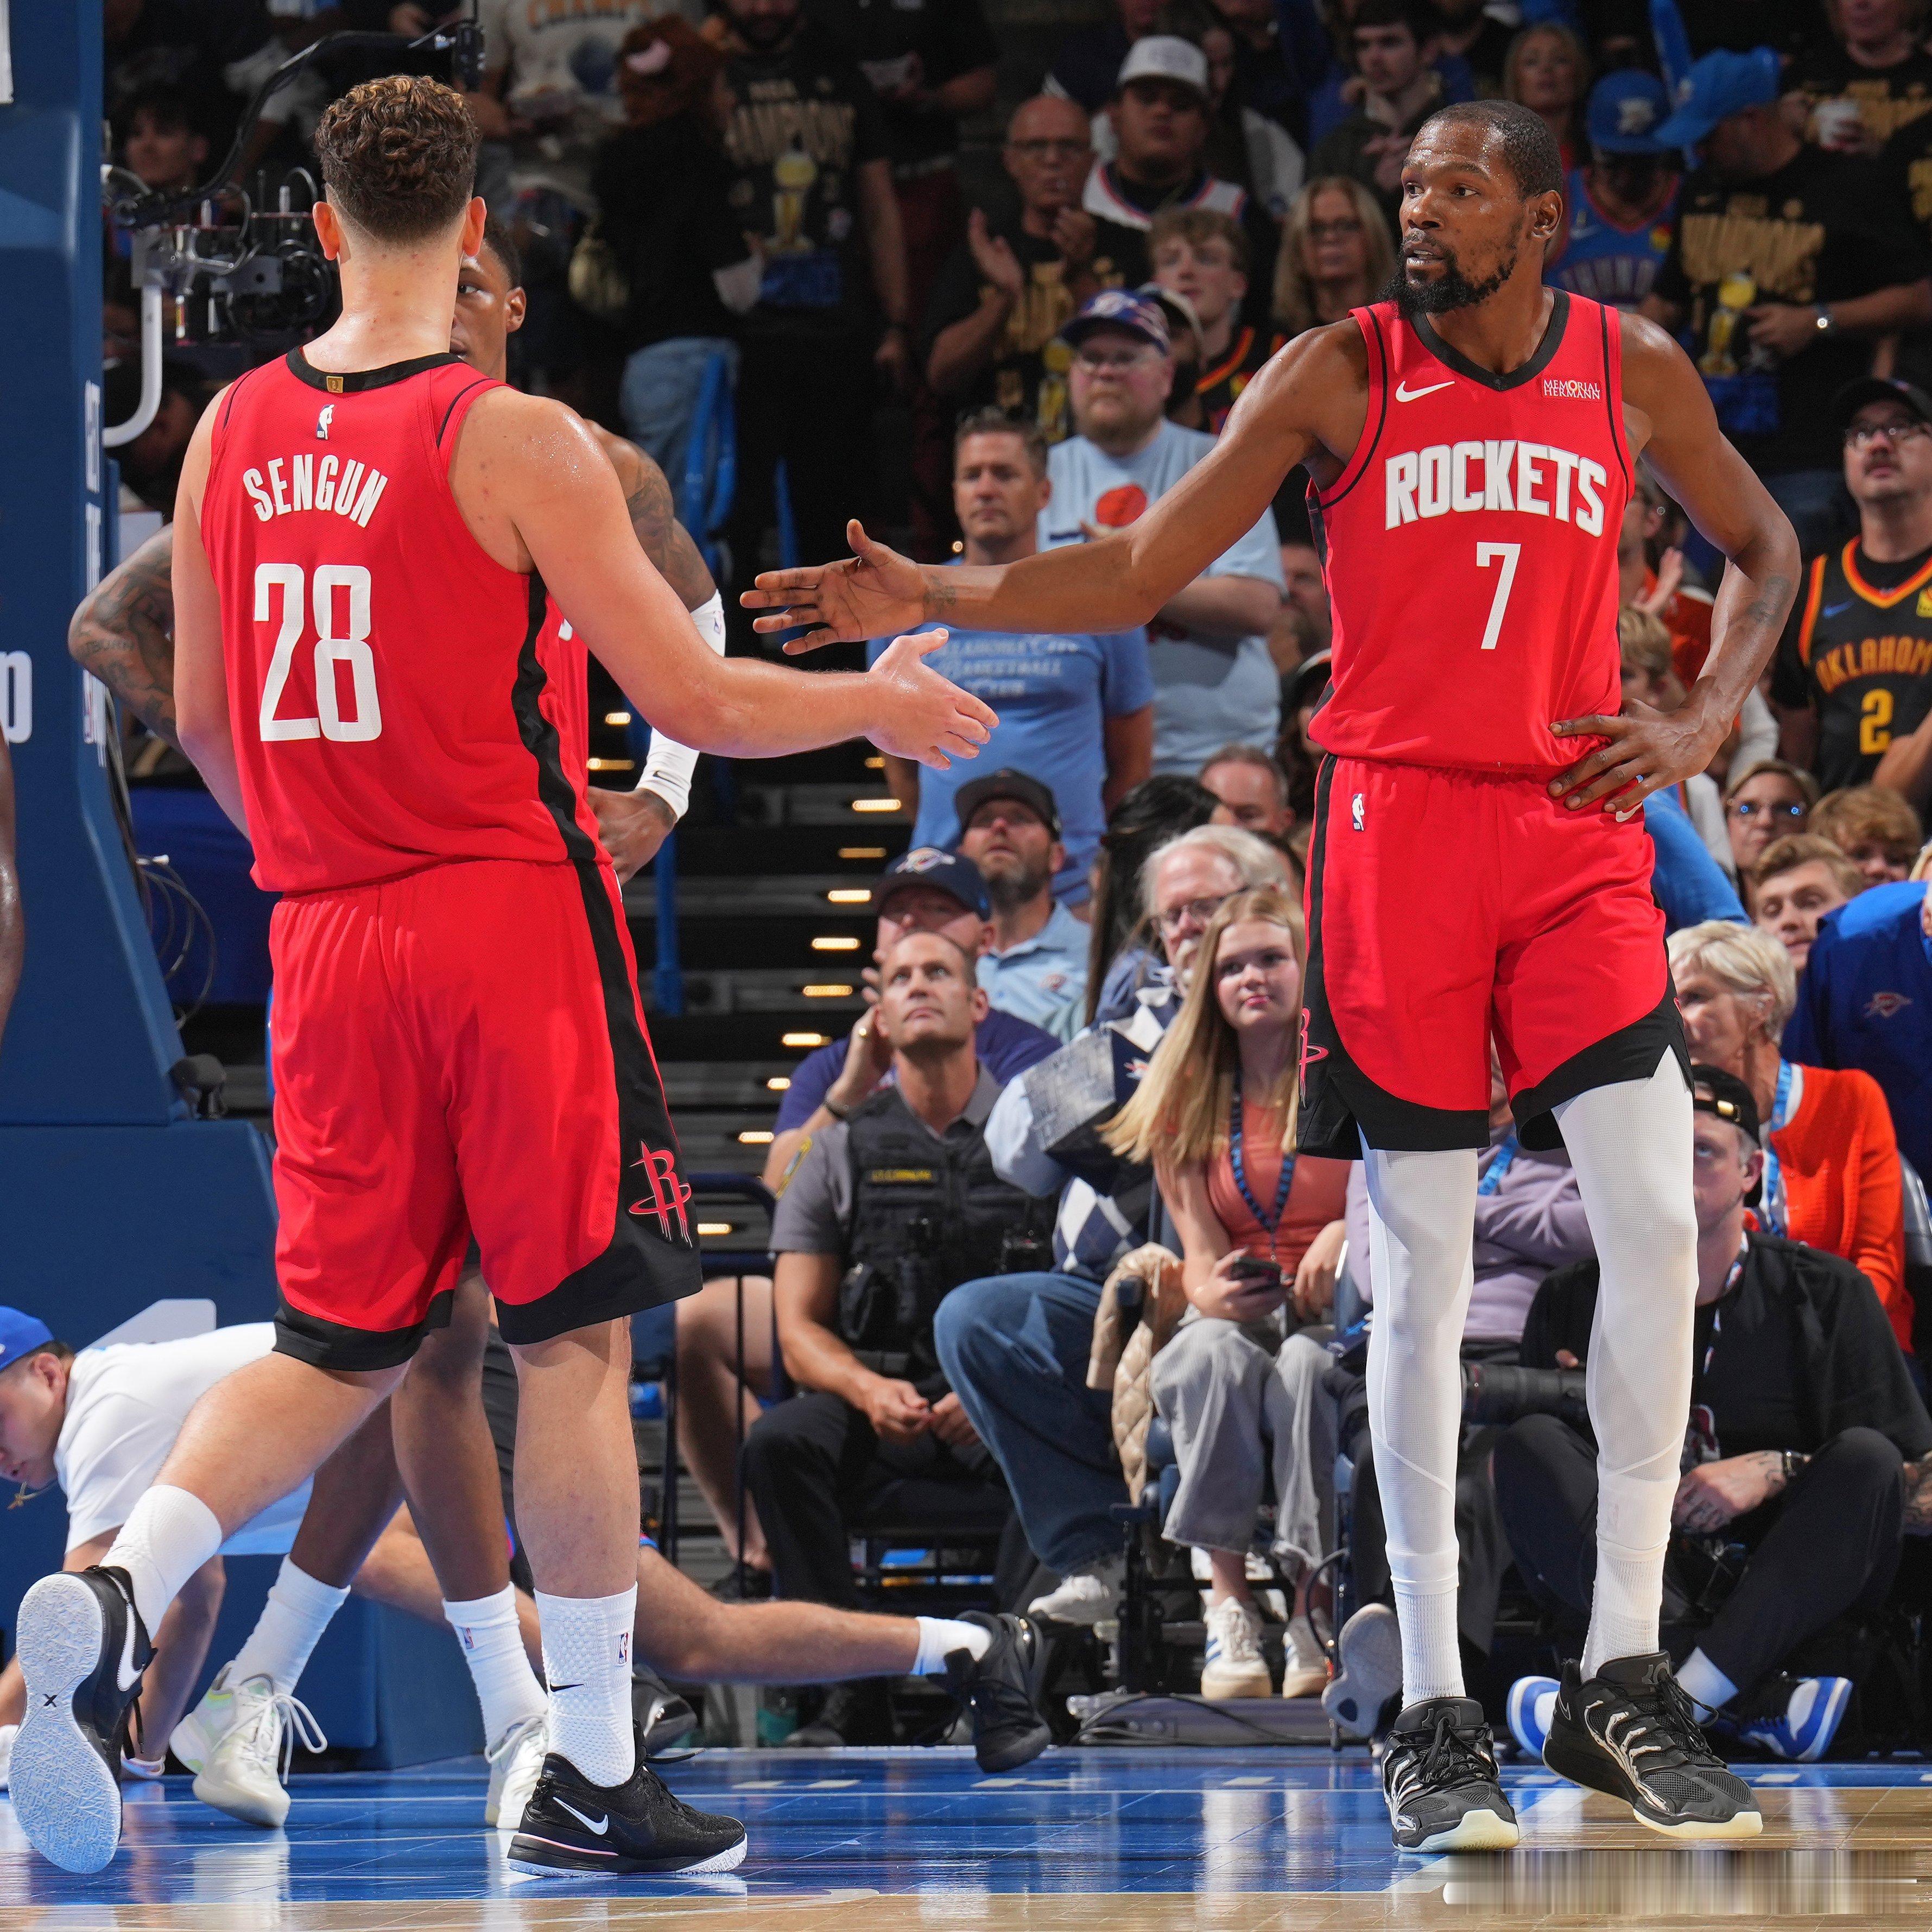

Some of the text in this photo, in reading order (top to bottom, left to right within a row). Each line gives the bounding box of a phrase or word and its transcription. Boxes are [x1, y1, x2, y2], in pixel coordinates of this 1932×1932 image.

[1544, 379, 1600, 392] MEMORIAL
[1544, 387, 1600, 400] HERMANN
[243, 453, 389, 528] SENGUN
[1385, 439, 1607, 537] ROCKETS
[1477, 541, 1522, 650] 7
[253, 562, 383, 742] 28
[1859, 688, 1895, 755] 2
